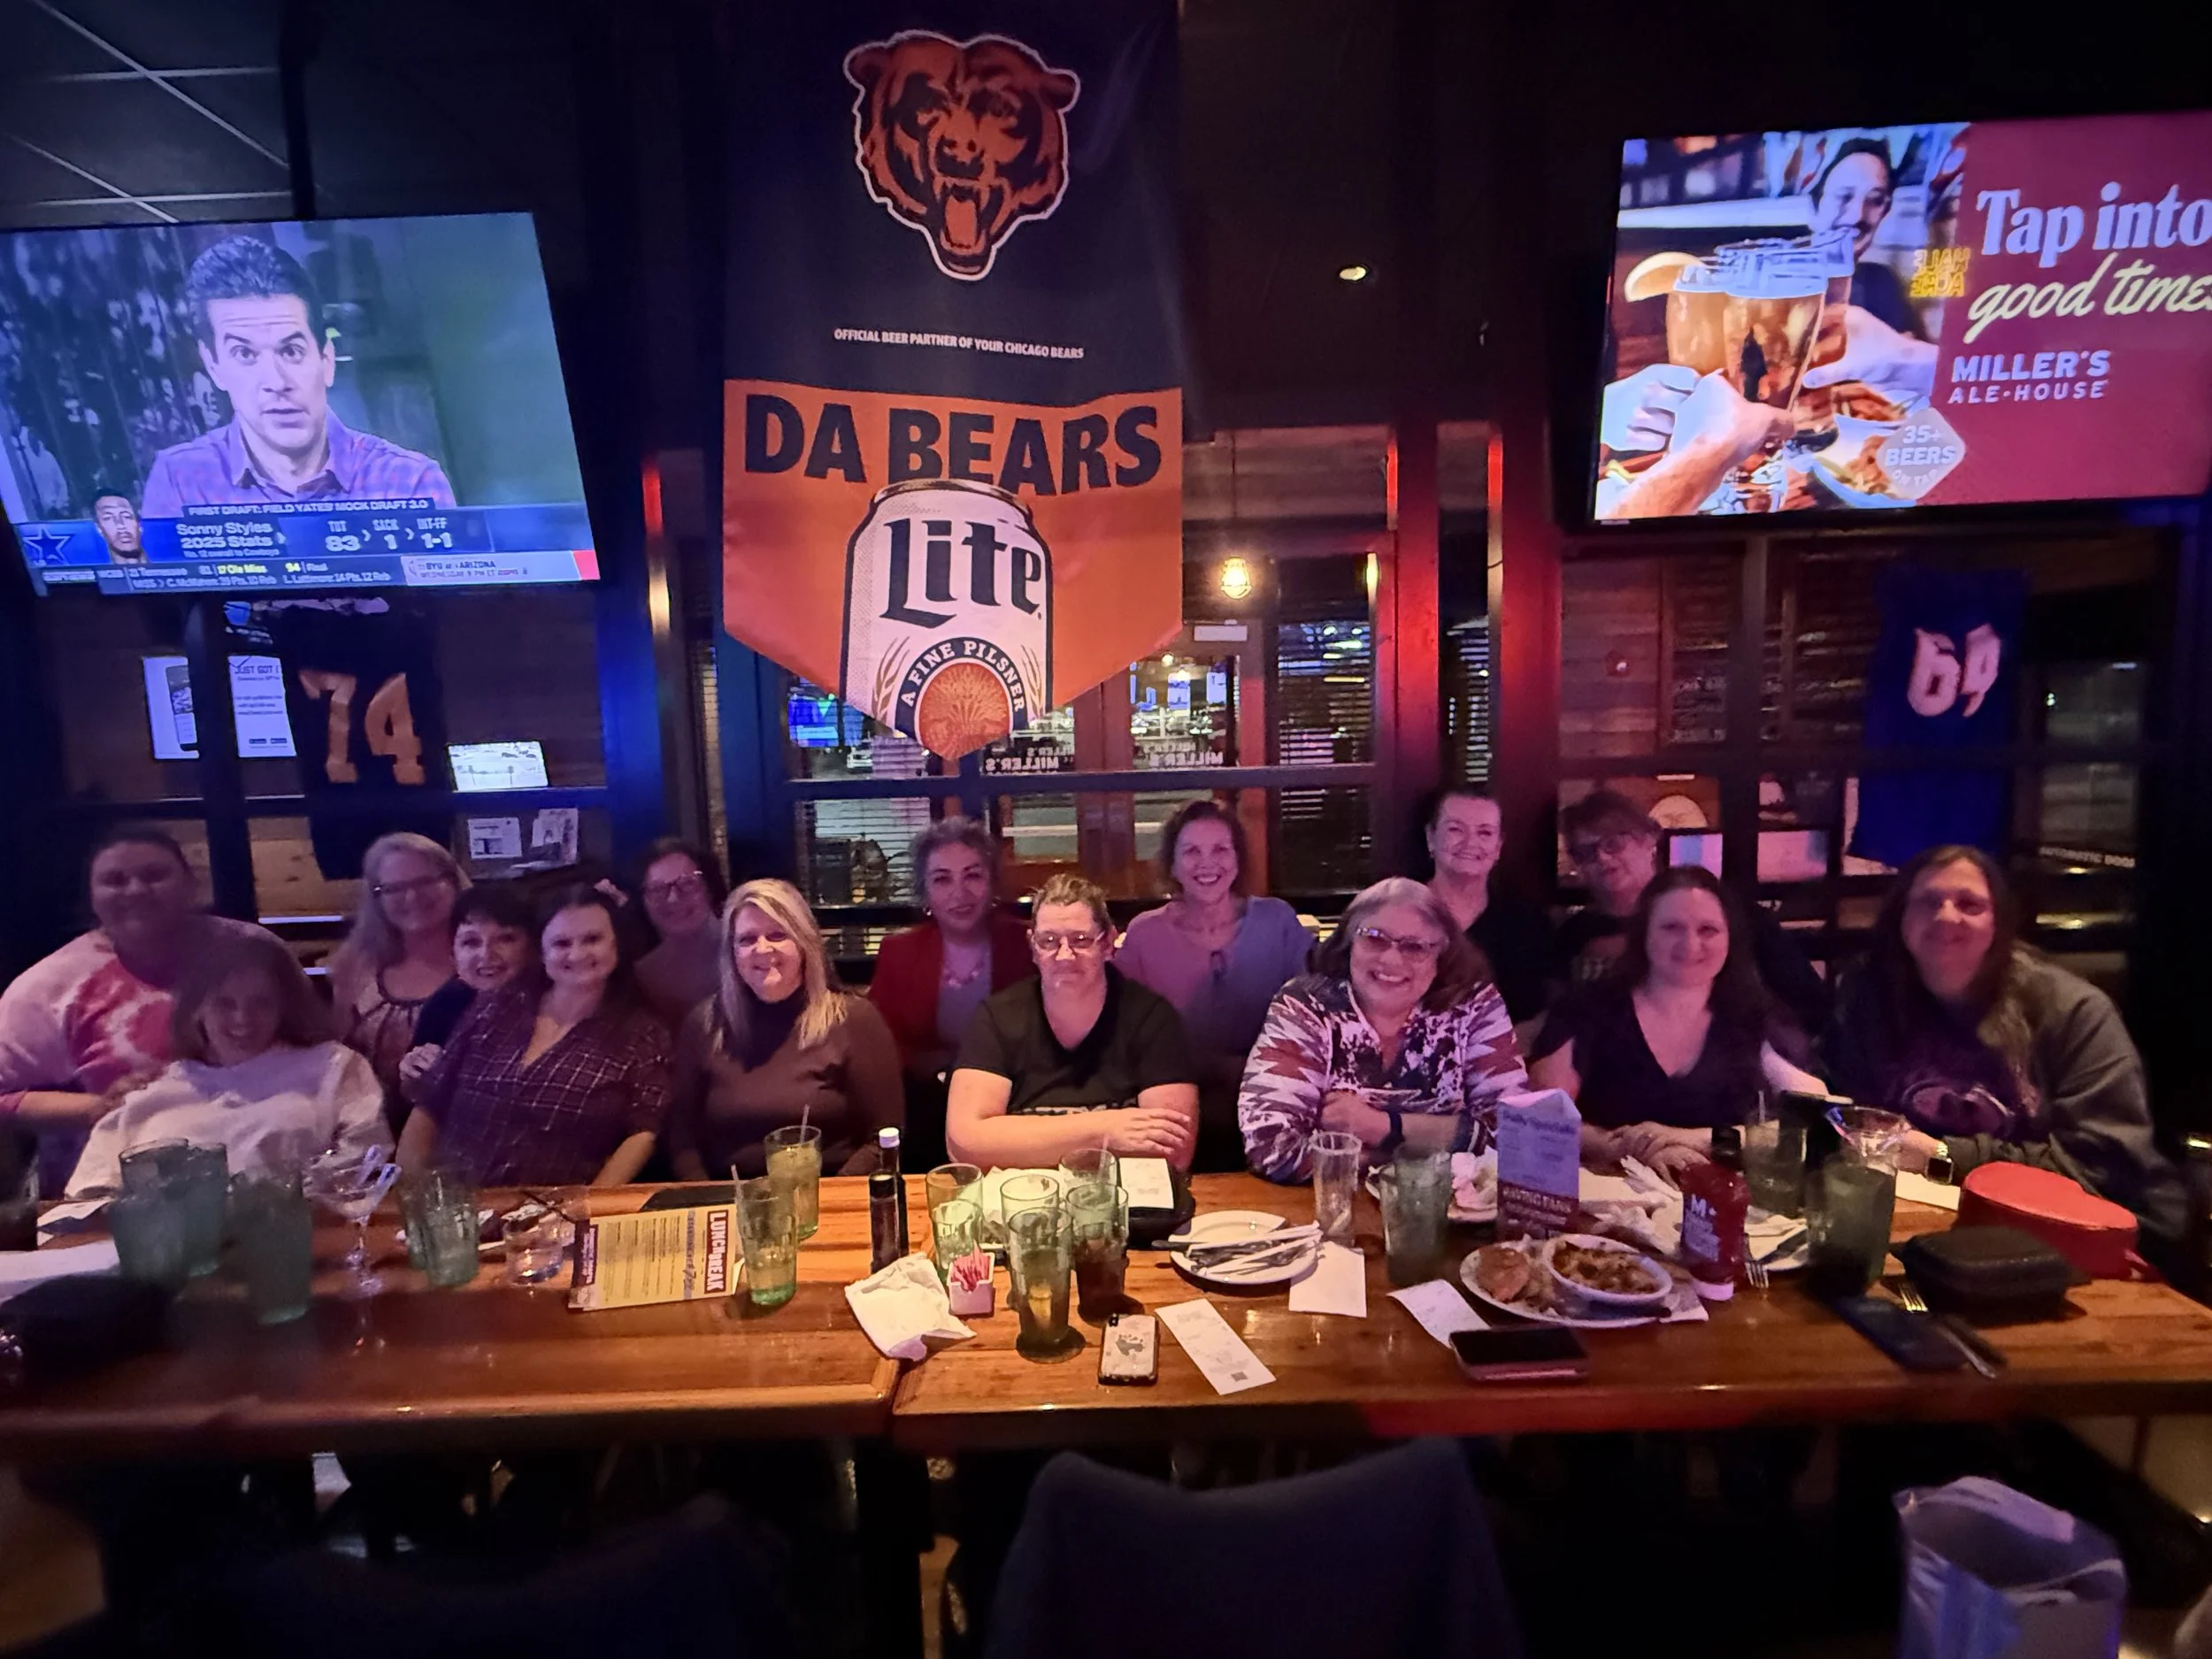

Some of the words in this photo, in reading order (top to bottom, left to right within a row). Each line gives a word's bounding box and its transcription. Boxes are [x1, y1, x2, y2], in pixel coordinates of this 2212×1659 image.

[1976, 188, 2085, 268] Tap
[2092, 181, 2212, 251] into
[1962, 252, 2119, 344] good
[2104, 259, 2212, 316] time
[833, 328, 880, 342] OFFICIAL
[881, 332, 909, 344] BEER
[910, 334, 958, 348] PARTNER
[958, 336, 973, 349] OF
[974, 338, 1003, 353] YOUR
[1004, 342, 1049, 357] CHICAGO
[1050, 347, 1084, 359] BEARS
[1951, 349, 2112, 383] MILLER'S
[745, 394, 867, 483] DA
[888, 405, 1162, 497] BEARS
[1902, 425, 1942, 444] 35+
[1886, 445, 1958, 467] BEERS
[188, 506, 220, 515] FIRST
[262, 503, 296, 514] FIELD
[334, 501, 370, 511] MOCK
[370, 500, 408, 511] DRAFT
[409, 499, 429, 510] 3.0
[176, 523, 223, 537] Sonny
[224, 520, 273, 536] Styles
[372, 518, 400, 531] SACK
[180, 536, 227, 549] 2025
[227, 534, 273, 548] Stats
[324, 534, 362, 552] 83
[383, 533, 397, 550] 1
[420, 531, 454, 549] 1-1
[426, 562, 442, 571] BYU
[459, 560, 496, 569] ARIZONA
[879, 518, 1041, 629] Lite
[908, 642, 956, 687] FINE
[964, 640, 1025, 712] PILSNER
[901, 691, 917, 708] A
[298, 670, 426, 786] 74
[710, 1211, 727, 1254] LUNCH
[706, 1250, 726, 1294] BREAK
